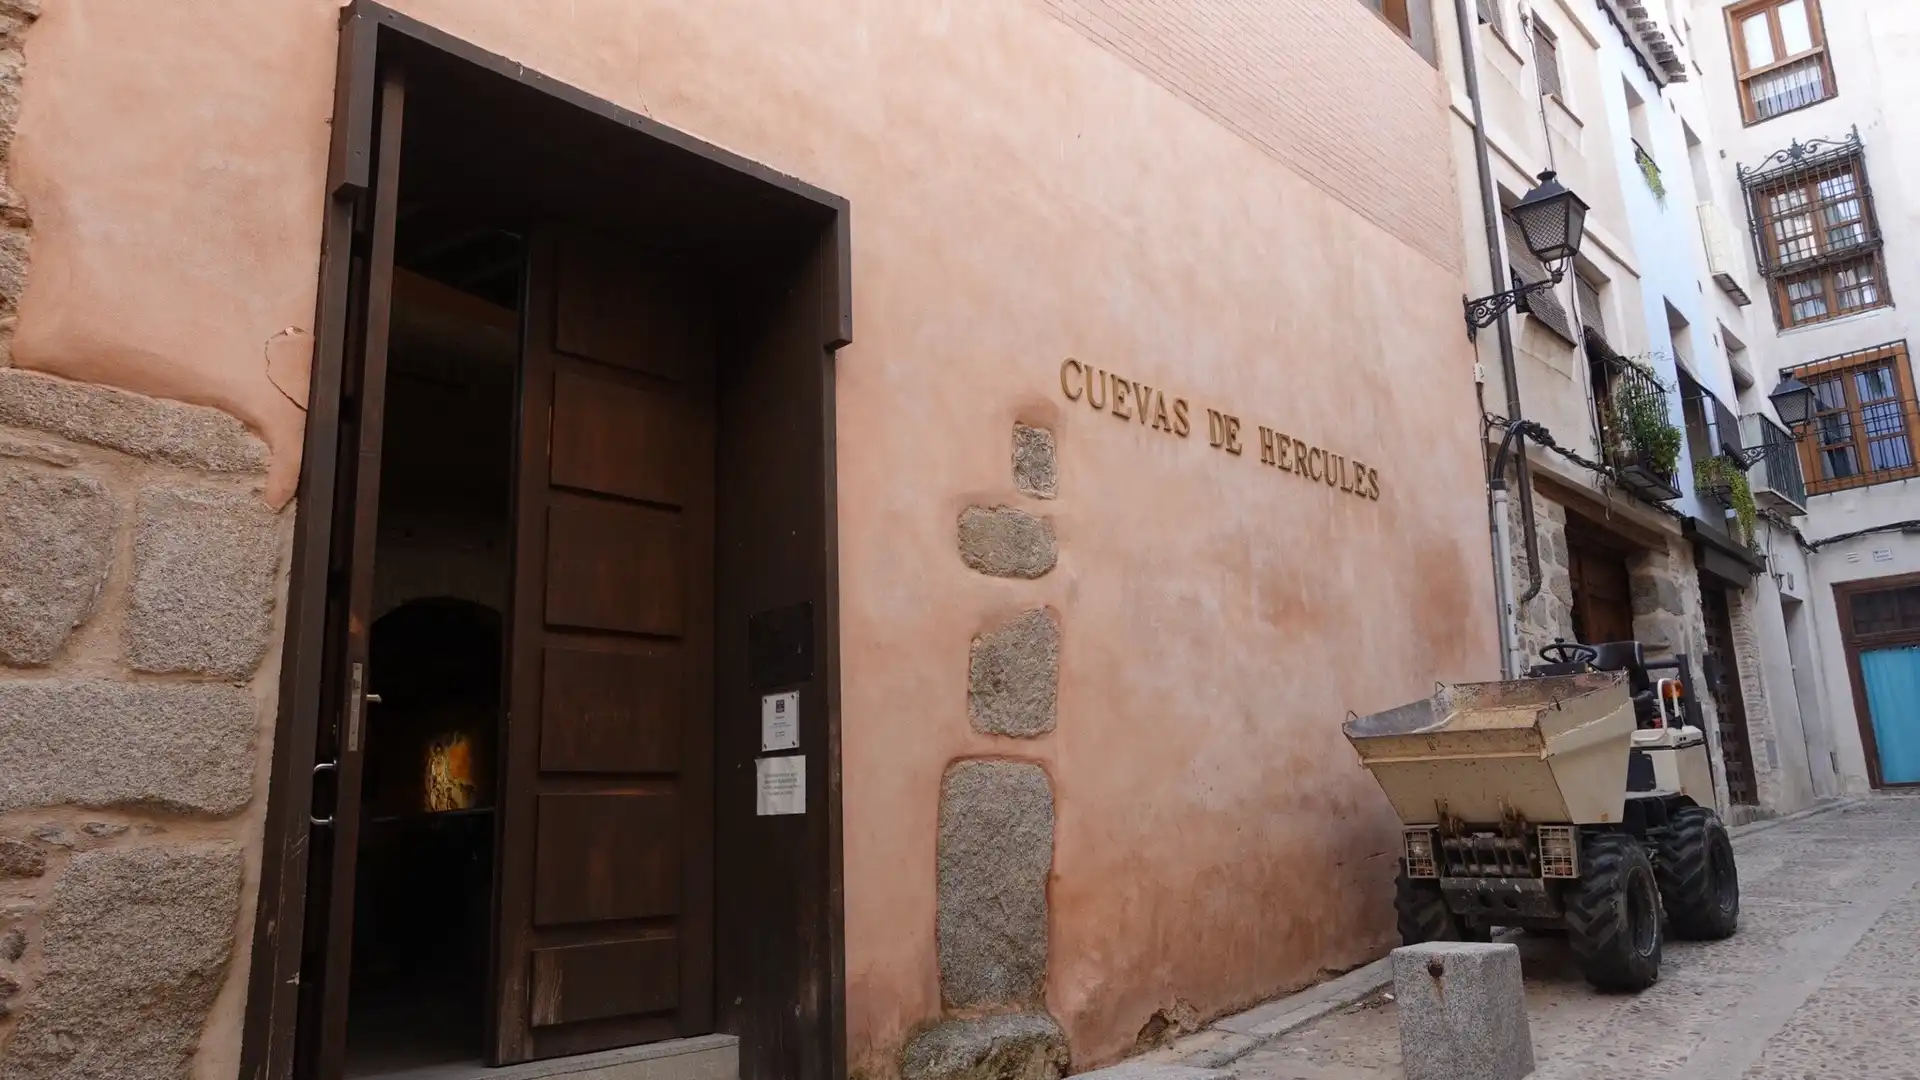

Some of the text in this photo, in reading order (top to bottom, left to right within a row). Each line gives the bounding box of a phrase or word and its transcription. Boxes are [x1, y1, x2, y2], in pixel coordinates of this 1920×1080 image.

[1060, 357, 1381, 501] CUEVAS DE HERCULES
